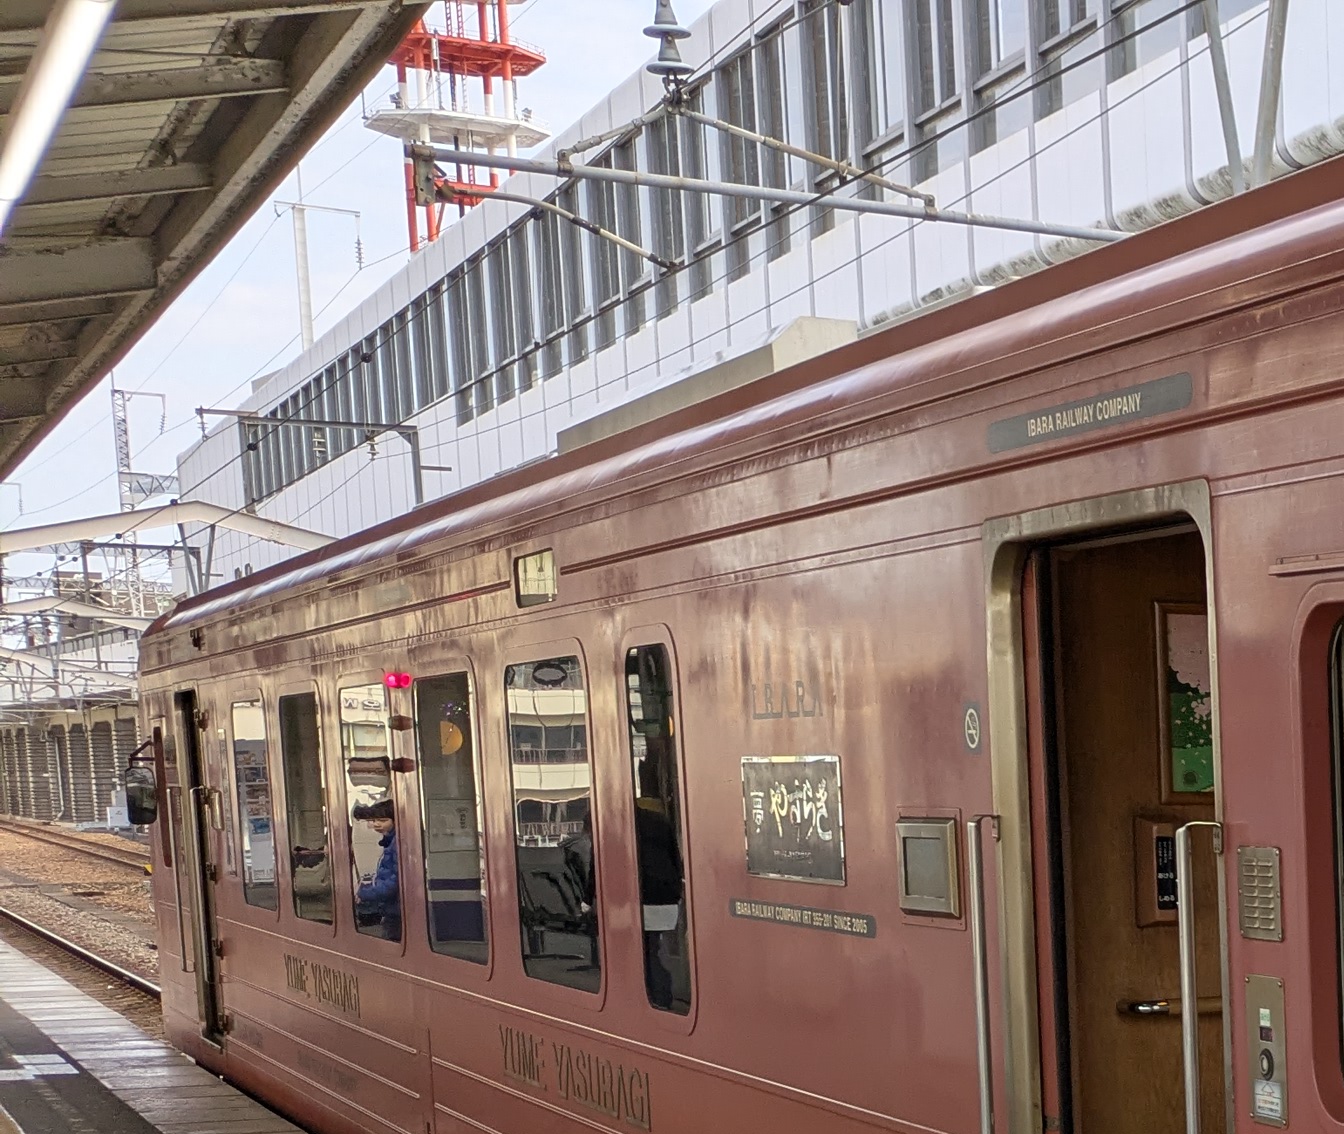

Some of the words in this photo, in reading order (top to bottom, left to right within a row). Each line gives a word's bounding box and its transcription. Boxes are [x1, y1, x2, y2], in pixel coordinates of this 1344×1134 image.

[1027, 414, 1054, 437] IBARA
[1056, 404, 1095, 431] RAILWAY
[1096, 392, 1142, 420] COMPANY
[735, 901, 751, 915] IBARA
[752, 903, 775, 918] RAILWAY
[775, 906, 802, 924] COMPANY
[833, 915, 852, 931] SINCE
[852, 918, 868, 934] 2005
[499, 1023, 548, 1092] YUME
[552, 1041, 653, 1133] YASURAGI
